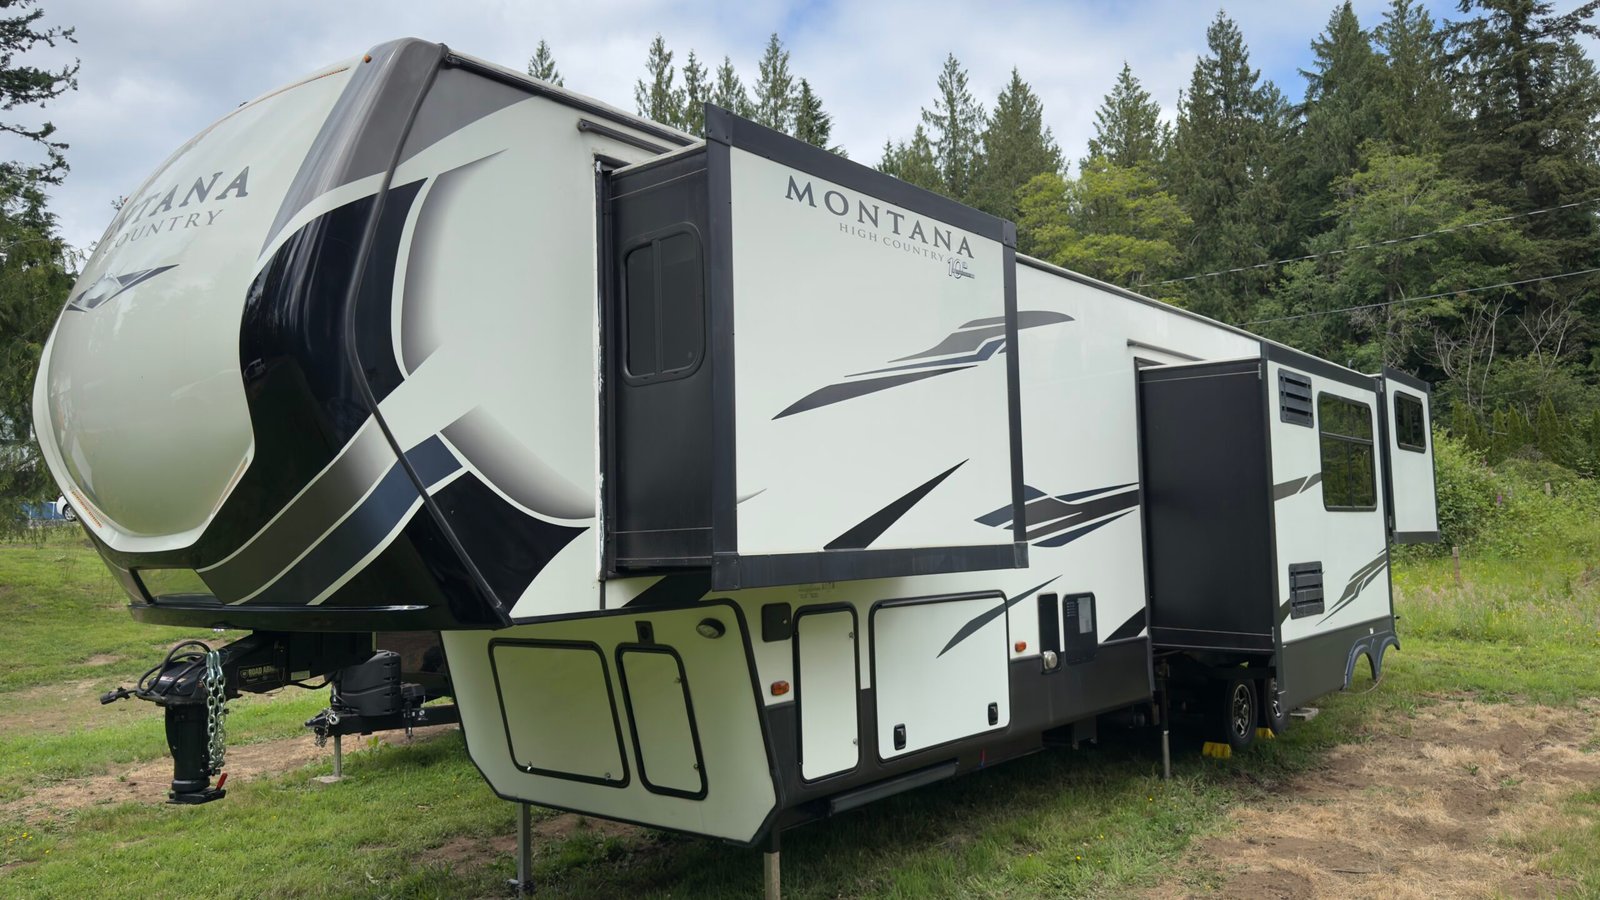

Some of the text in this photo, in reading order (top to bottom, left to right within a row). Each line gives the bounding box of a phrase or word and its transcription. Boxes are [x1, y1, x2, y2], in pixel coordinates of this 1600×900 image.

[116, 165, 250, 233] NTANA
[784, 175, 975, 259] MONTANA
[114, 208, 224, 248] OUNTRY
[839, 222, 945, 262] HIGH COUNTRY
